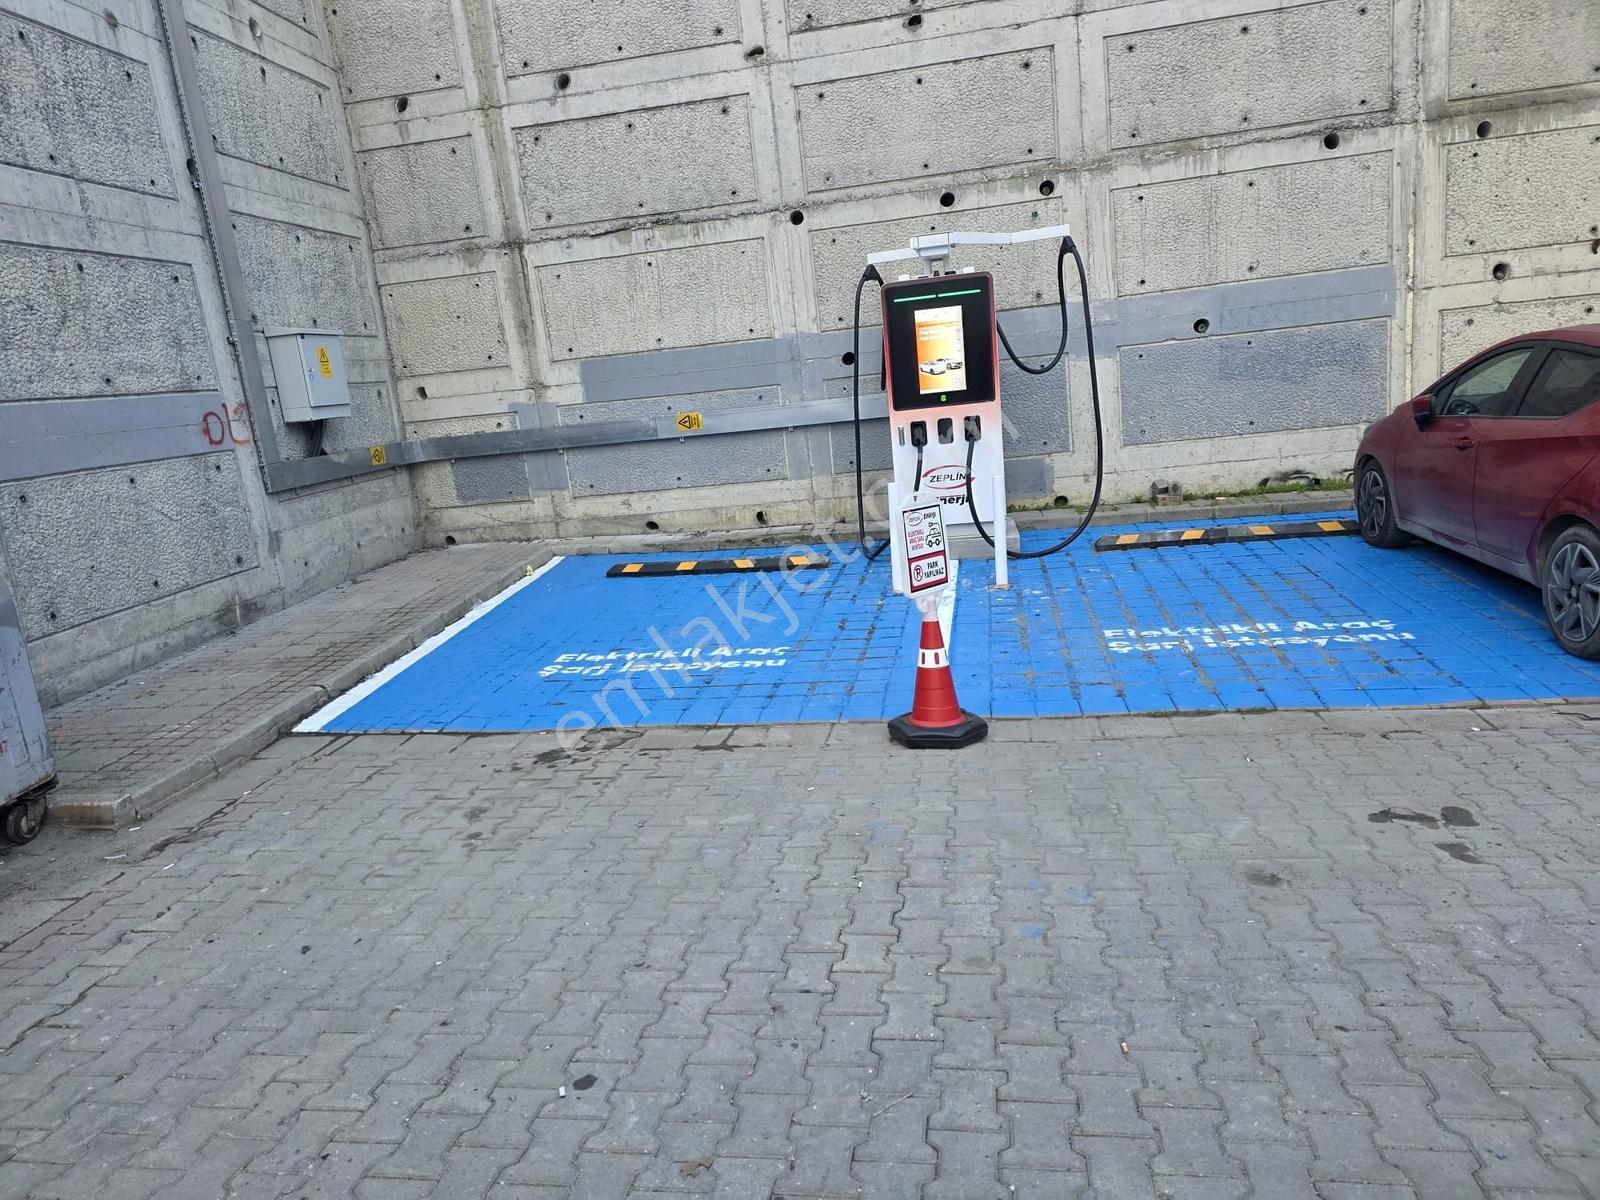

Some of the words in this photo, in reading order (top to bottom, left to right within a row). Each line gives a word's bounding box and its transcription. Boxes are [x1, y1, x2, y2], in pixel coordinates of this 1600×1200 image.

[924, 567, 944, 579] YAPILMAZ
[927, 560, 939, 570] PARK
[1103, 622, 1283, 638] Elektrikli
[1293, 619, 1398, 632] Araç
[553, 648, 702, 663] Elektrikli
[709, 646, 792, 657] Araç
[538, 662, 613, 678] Şarj
